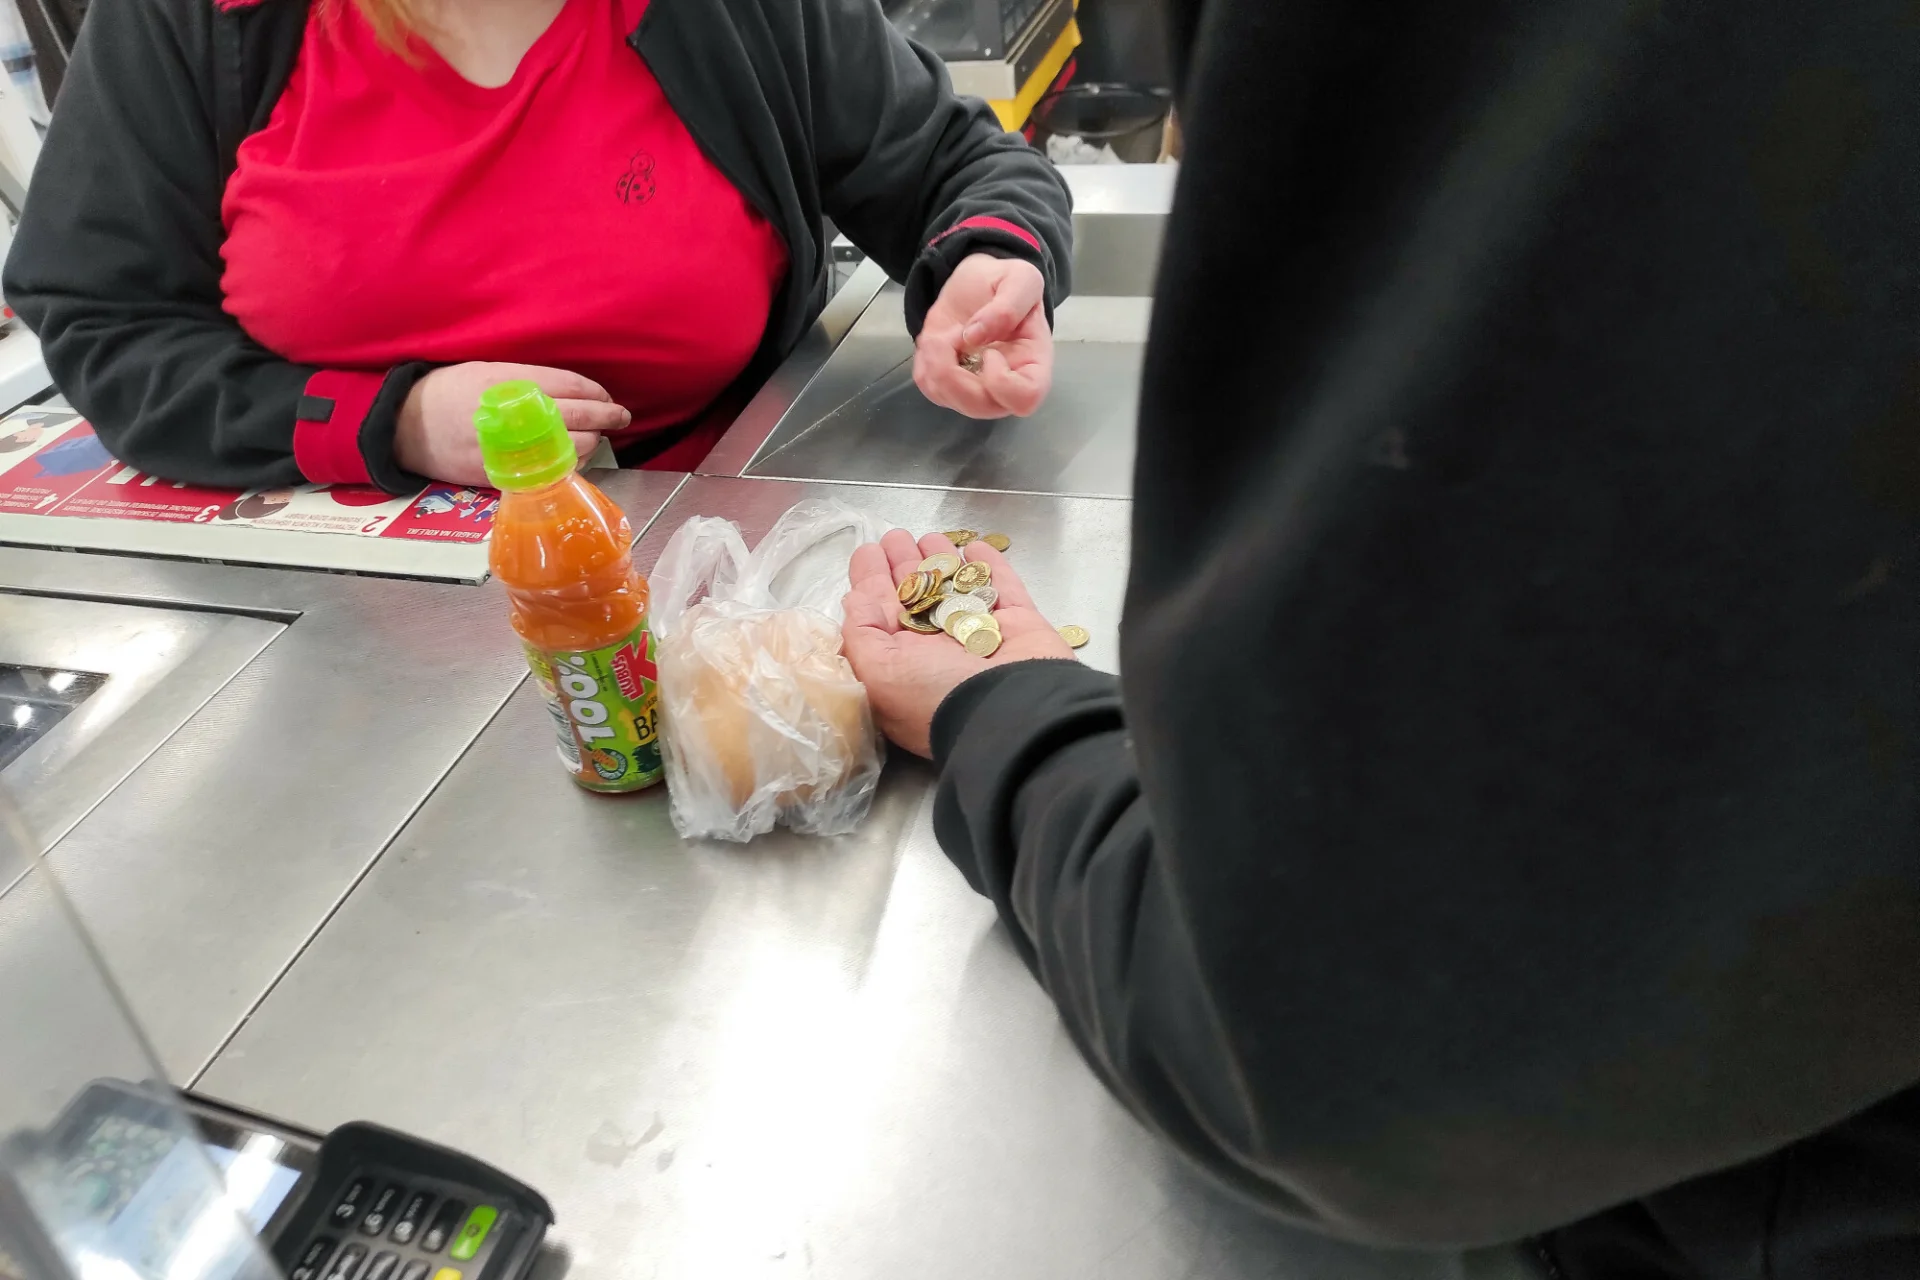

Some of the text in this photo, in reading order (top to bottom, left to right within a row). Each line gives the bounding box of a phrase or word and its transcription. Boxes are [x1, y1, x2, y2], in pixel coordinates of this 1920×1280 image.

[193, 504, 220, 522] 3
[361, 515, 388, 533] 2
[439, 530, 453, 538] NA
[554, 655, 615, 743] 100%
[335, 1203, 355, 1218] 3
